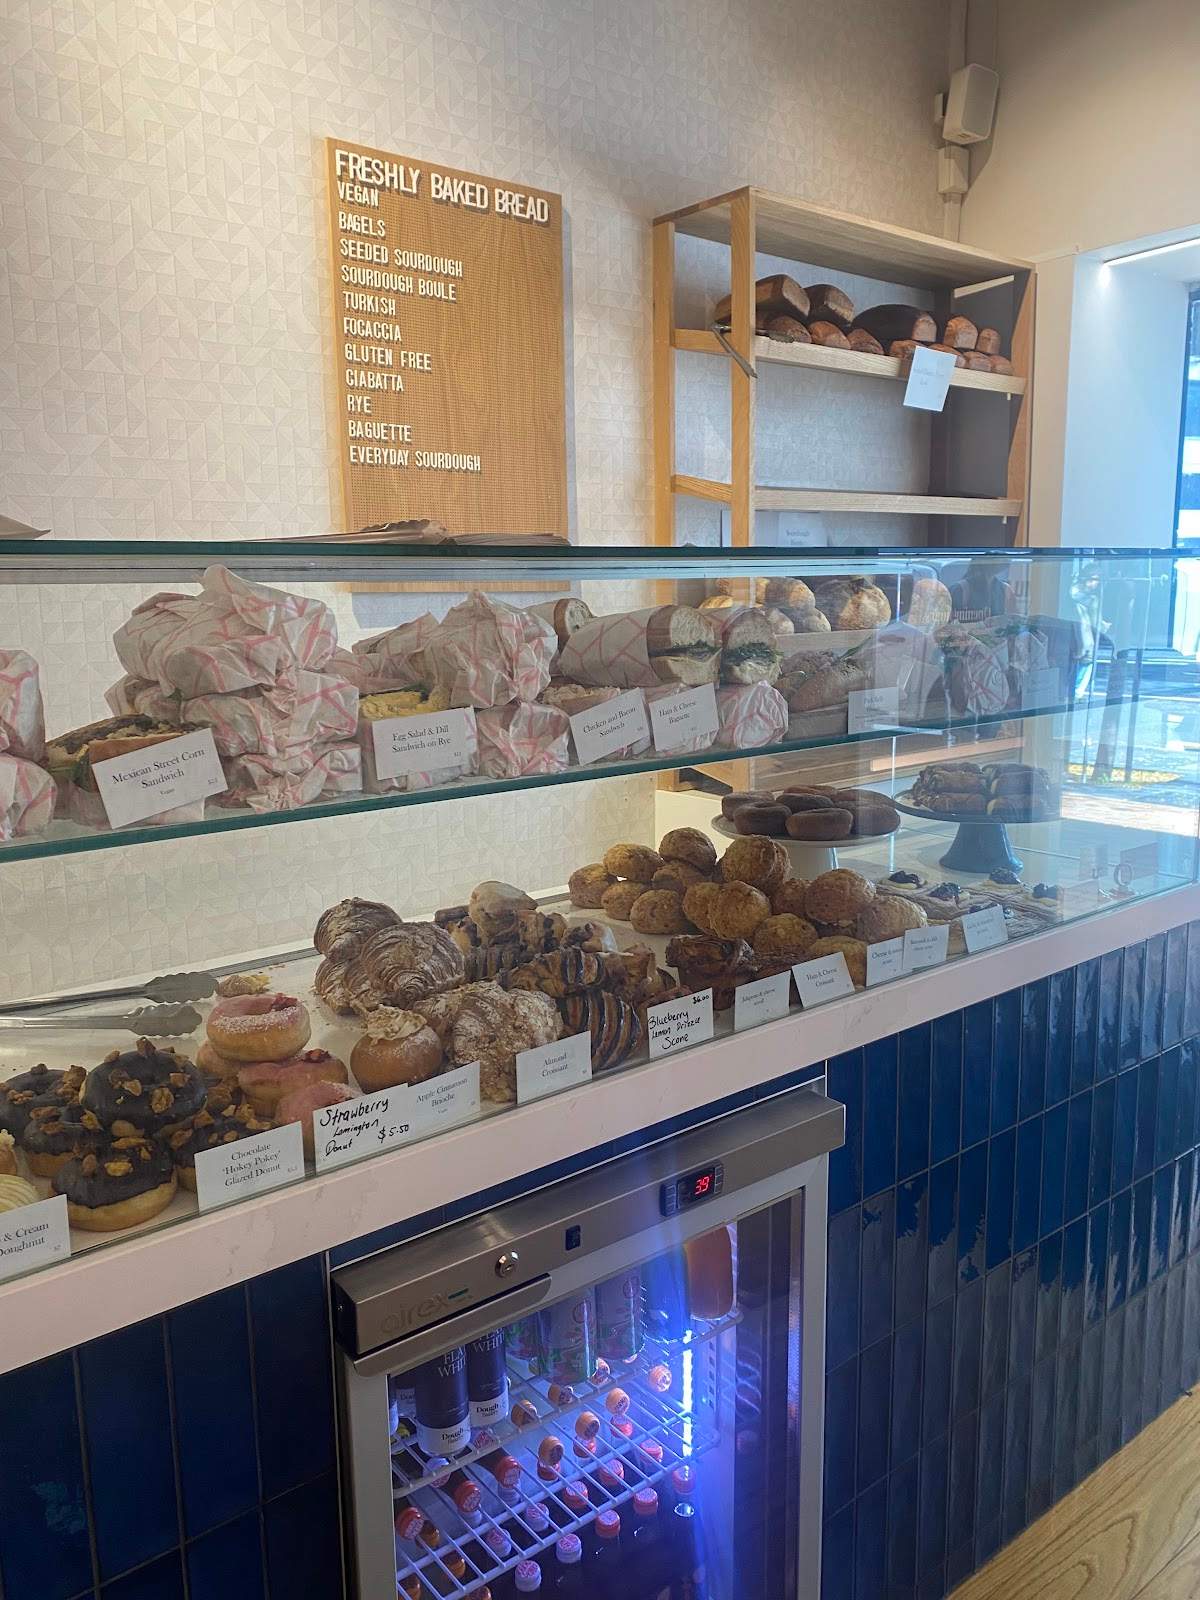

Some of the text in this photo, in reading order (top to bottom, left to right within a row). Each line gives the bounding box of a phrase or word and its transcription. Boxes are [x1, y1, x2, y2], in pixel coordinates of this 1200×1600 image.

[335, 149, 549, 223] FRESHLY BAKED BREAD
[337, 180, 379, 207] VEGAN
[338, 211, 386, 237] BAGELS
[339, 239, 463, 277] SEEDED SOURDOUGH
[341, 265, 456, 301] SOURDOUGH BOULE
[343, 291, 396, 316] TURKISH
[343, 317, 402, 342] FOCACCIA
[344, 343, 432, 371] GLUTEN FREE
[345, 369, 404, 392] CIABATTA
[347, 395, 372, 413] RYE
[348, 419, 412, 442] BAGUETTE
[349, 445, 481, 471] EVERYDAY SOURDOUGH
[583, 707, 636, 734] Chicken and Bacon
[407, 728, 426, 739] Salad
[392, 741, 426, 754] Sandwich
[112, 749, 206, 784] Mexican Street Corn
[140, 768, 185, 789] Sandwich
[647, 1011, 689, 1030] Blueberry
[661, 1033, 689, 1050] Scone
[319, 1097, 390, 1127] Strawberry
[231, 1143, 272, 1161] Chocolate
[325, 1138, 353, 1157] Donut
[224, 1170, 254, 1187] Glazed
[255, 1163, 281, 1177] Donut
[3, 1223, 49, 1242] & Cream
[475, 1403, 499, 1413] Dough
